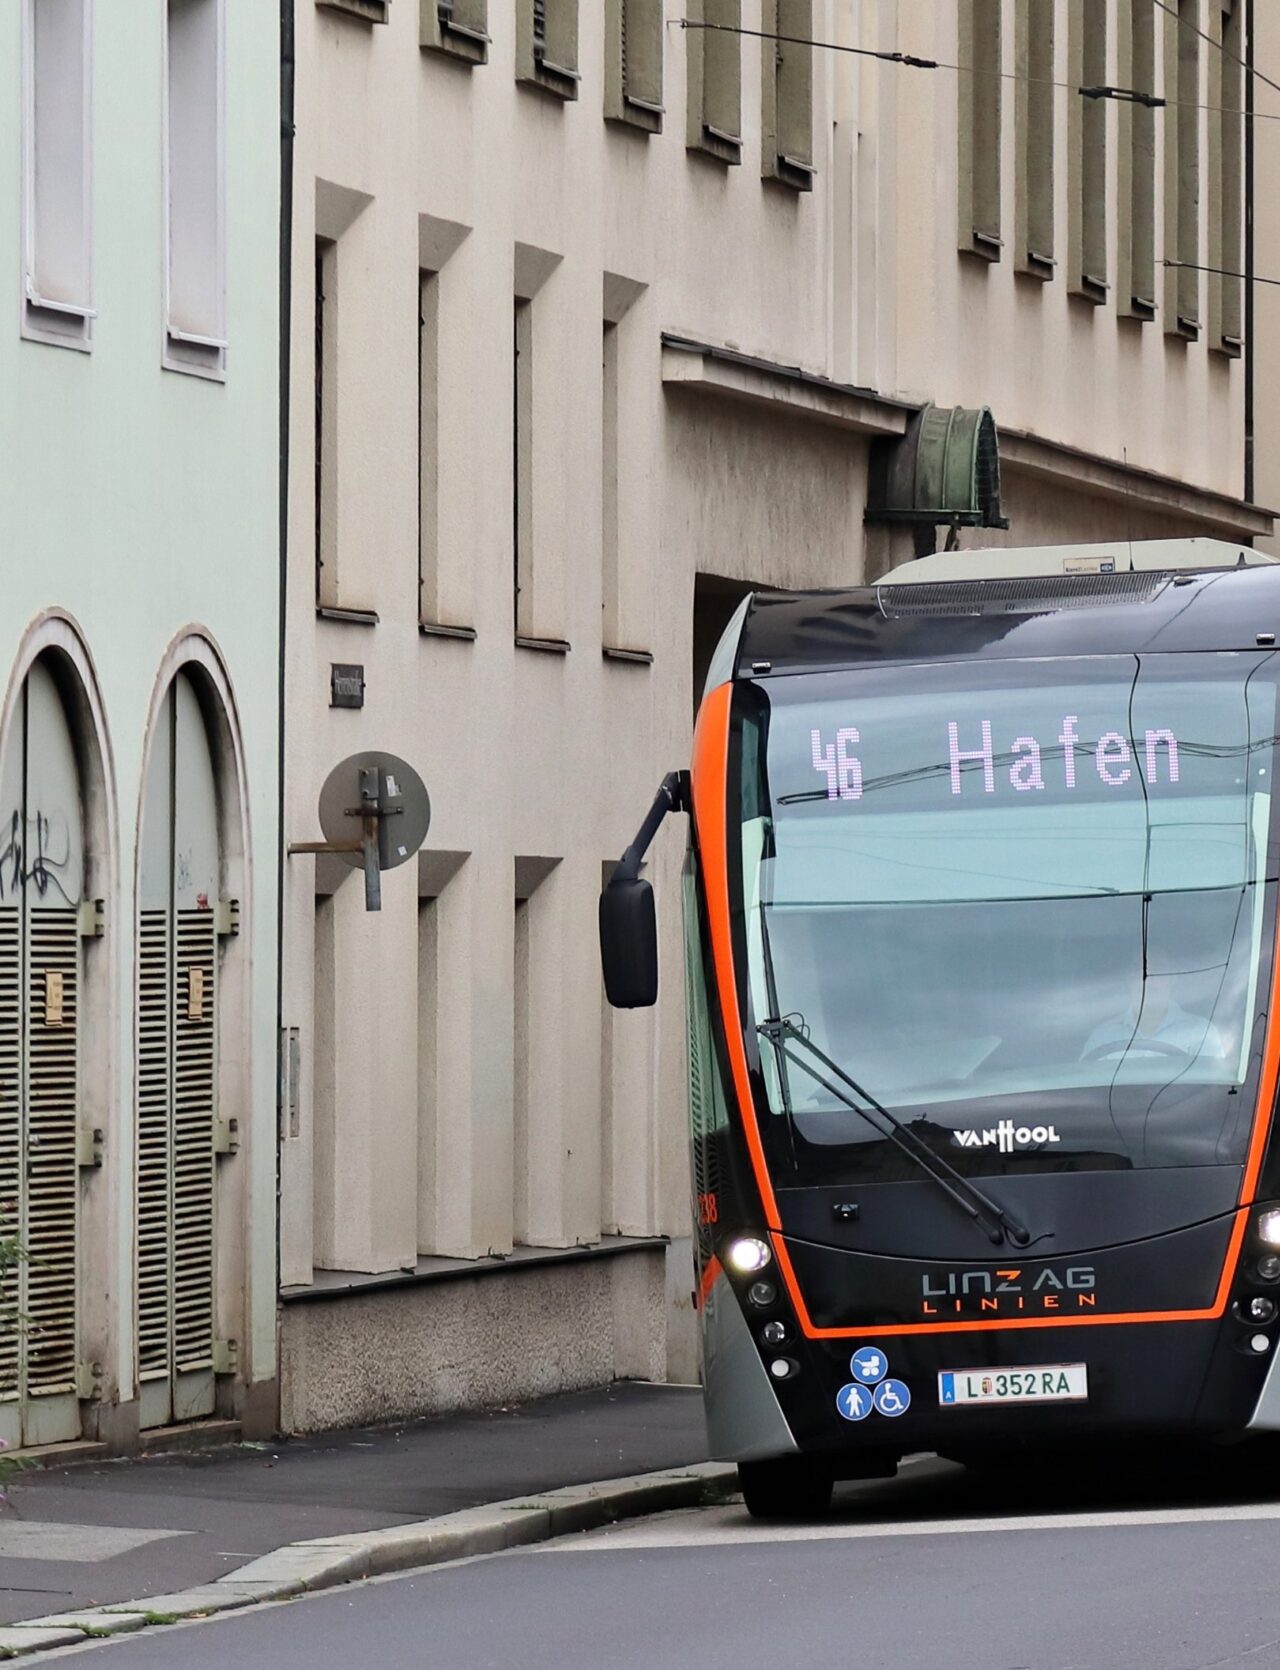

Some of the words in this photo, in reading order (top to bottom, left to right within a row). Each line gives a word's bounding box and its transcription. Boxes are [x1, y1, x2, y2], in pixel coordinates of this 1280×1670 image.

[811, 727, 863, 800] 46
[948, 715, 1179, 795] Hafen
[922, 1270, 1022, 1296] LINZ
[1032, 1266, 1096, 1291] AG
[922, 1293, 1096, 1314] LINIEN
